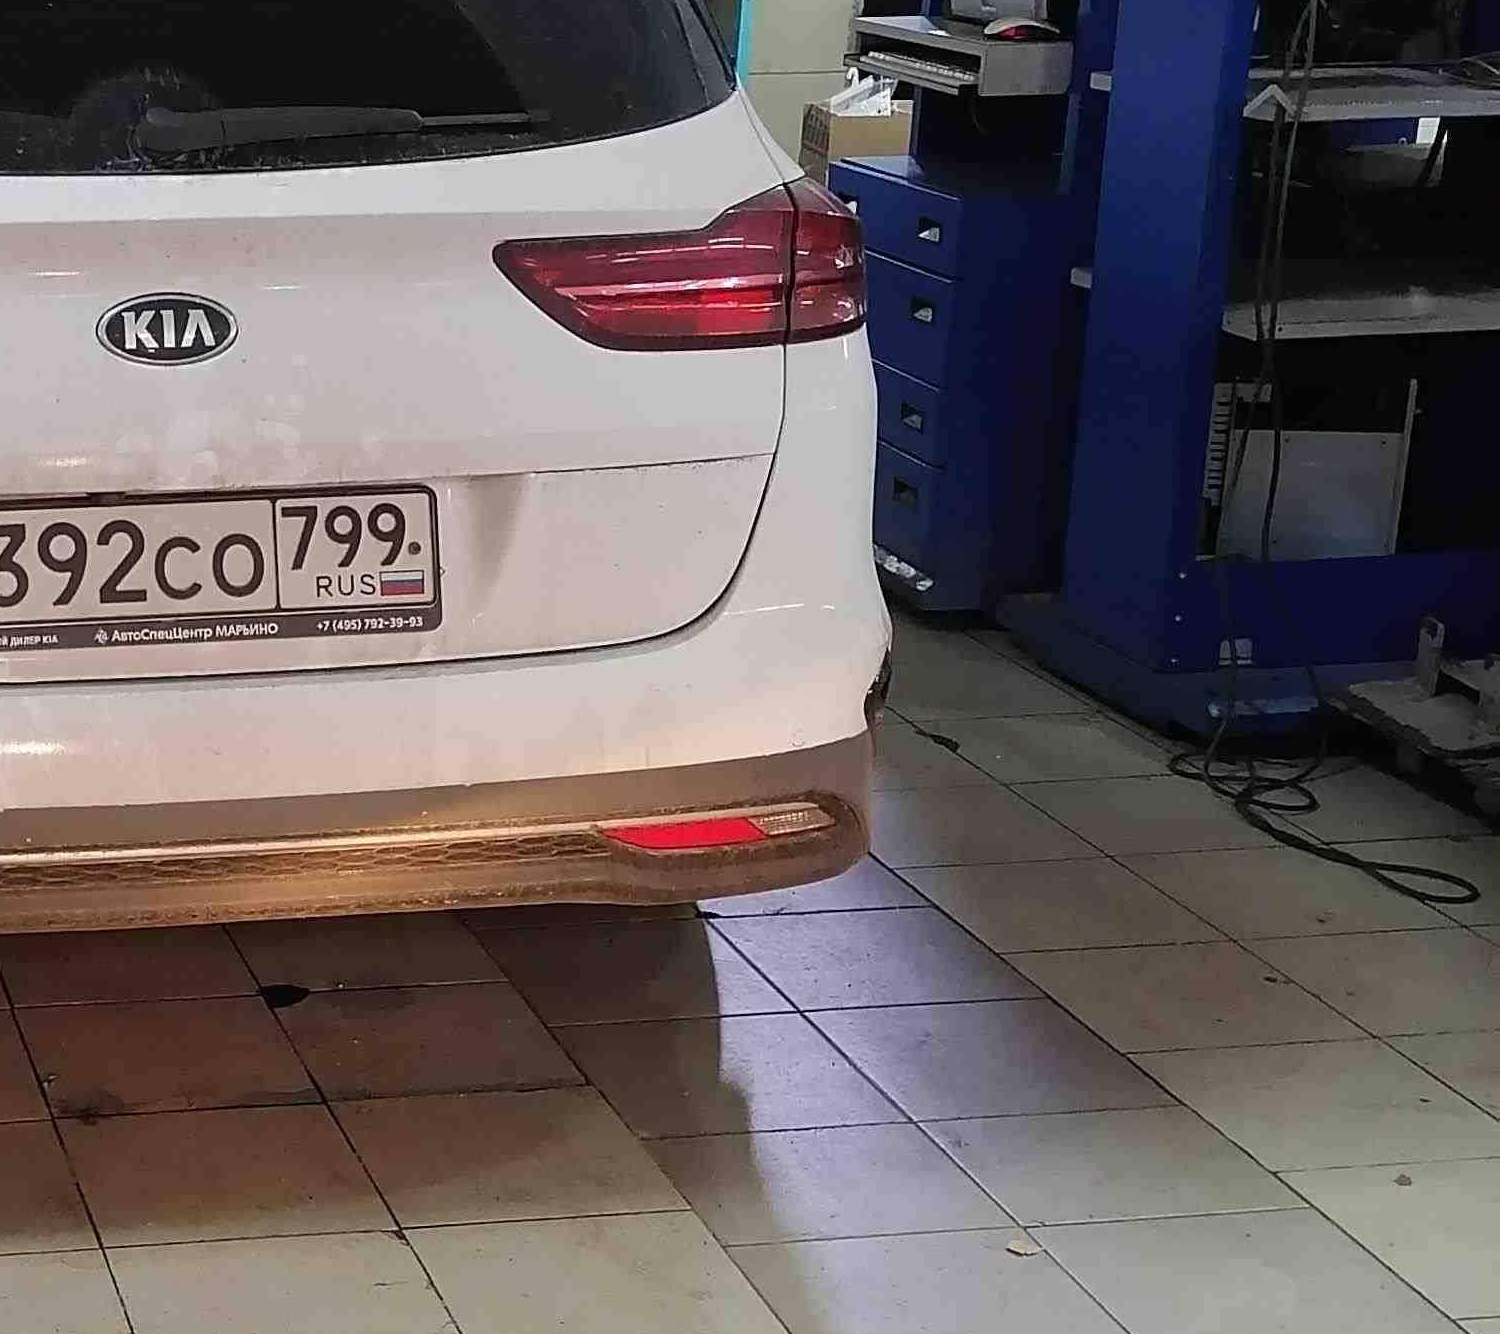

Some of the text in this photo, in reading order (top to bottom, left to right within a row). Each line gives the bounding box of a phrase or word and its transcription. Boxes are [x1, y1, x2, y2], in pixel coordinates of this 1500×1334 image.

[121, 309, 215, 350] KIA
[280, 502, 406, 571] 799
[315, 573, 377, 598] RUS
[111, 622, 279, 643] АвтоСпецЦентр МАРЬИНО
[316, 615, 424, 632] +7 (495) 792-39-93
[9, 635, 41, 648] ДИЛЕР
[42, 634, 59, 644] KIA
